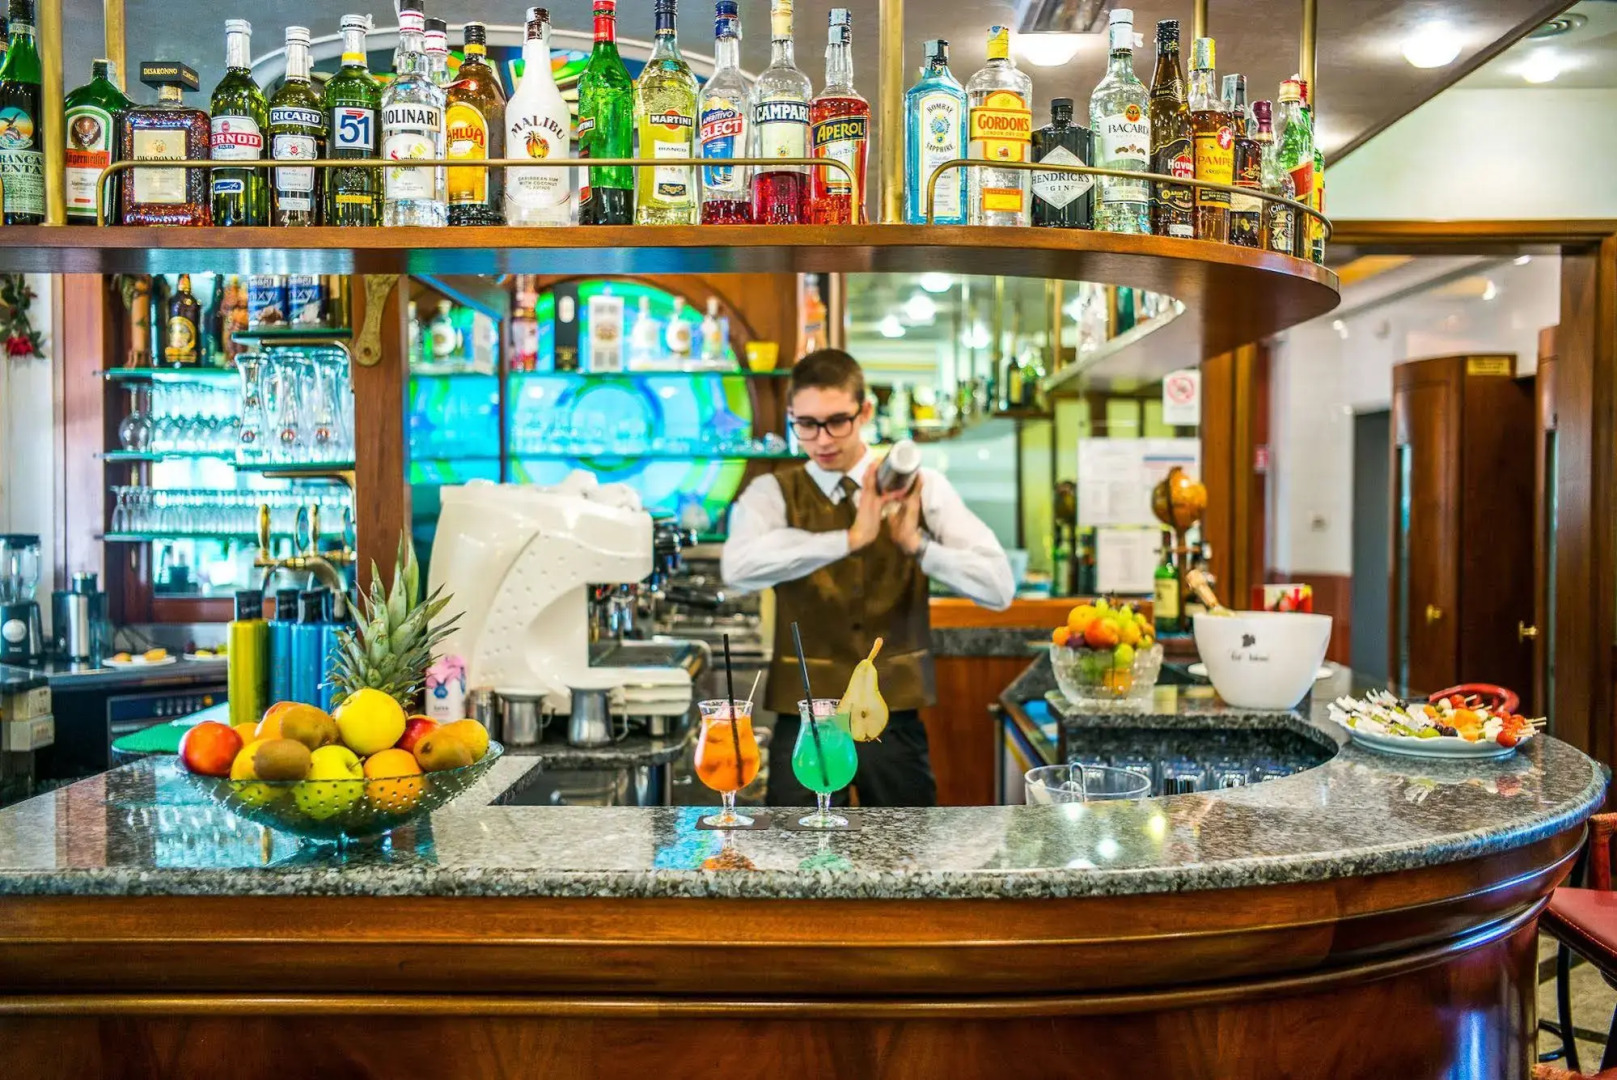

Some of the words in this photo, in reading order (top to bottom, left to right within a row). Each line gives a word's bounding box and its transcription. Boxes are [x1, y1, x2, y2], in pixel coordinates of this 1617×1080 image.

[143, 67, 178, 75] DISARONNO
[926, 103, 954, 114] BOMBAY
[272, 111, 320, 123] RICARD
[651, 115, 692, 126] MARTINI
[703, 110, 733, 124] APERITIVO
[339, 114, 370, 145] 51
[511, 115, 565, 140] MALIBU
[817, 122, 863, 144] APEROL
[926, 143, 954, 153] SAPPHIRE
